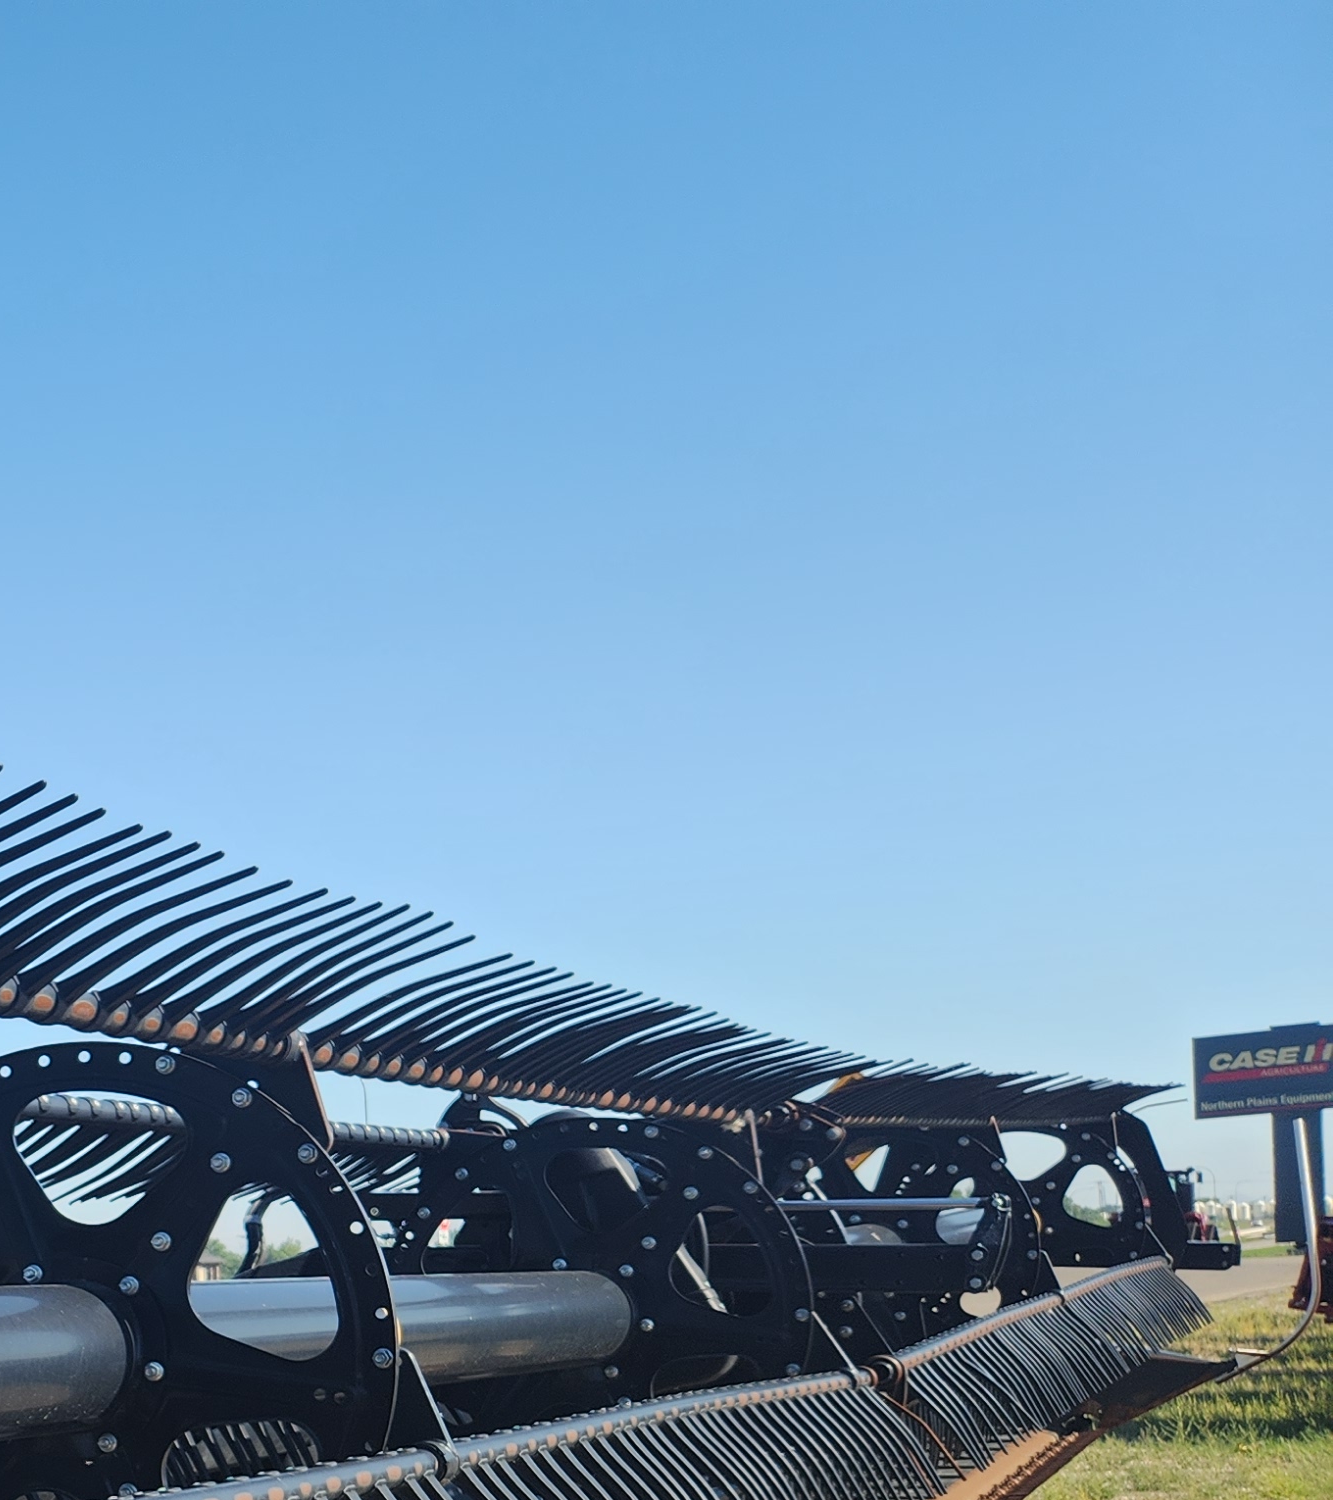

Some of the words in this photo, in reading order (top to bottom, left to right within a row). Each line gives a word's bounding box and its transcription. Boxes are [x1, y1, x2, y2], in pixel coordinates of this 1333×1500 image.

[1209, 1045, 1301, 1072] CASE
[1260, 1063, 1327, 1077] AGRICULTURE
[1200, 1098, 1245, 1112] Northern
[1246, 1096, 1278, 1107] Plains
